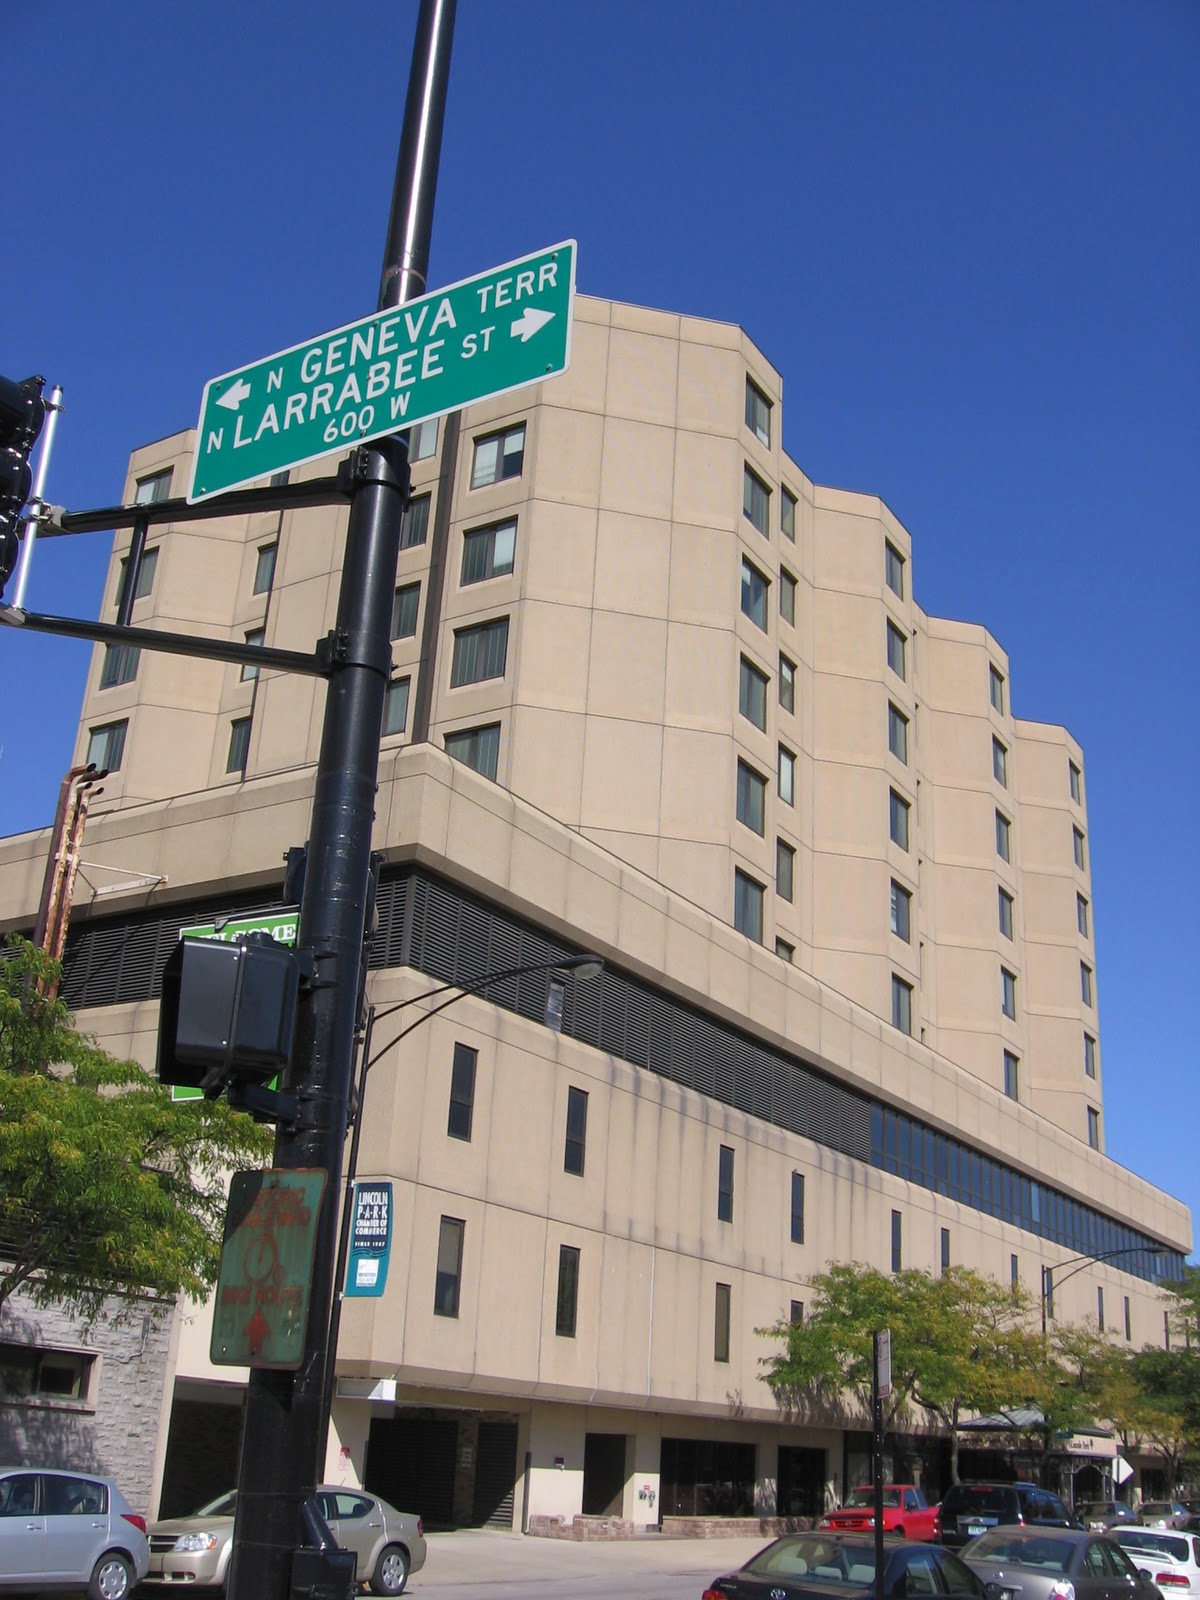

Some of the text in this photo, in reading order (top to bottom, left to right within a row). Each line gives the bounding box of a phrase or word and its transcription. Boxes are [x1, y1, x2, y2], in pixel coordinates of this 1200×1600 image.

[266, 262, 559, 394] N GENEVA TERR
[206, 325, 496, 454] N LARRABEE ST
[322, 391, 412, 444] 600 W
[199, 923, 296, 943] LCME
[241, 1186, 306, 1207] STORIC
[358, 1191, 388, 1205] LINCOLN
[355, 1227, 387, 1235] COMMERCE
[356, 1219, 388, 1227] CHAMBER OF
